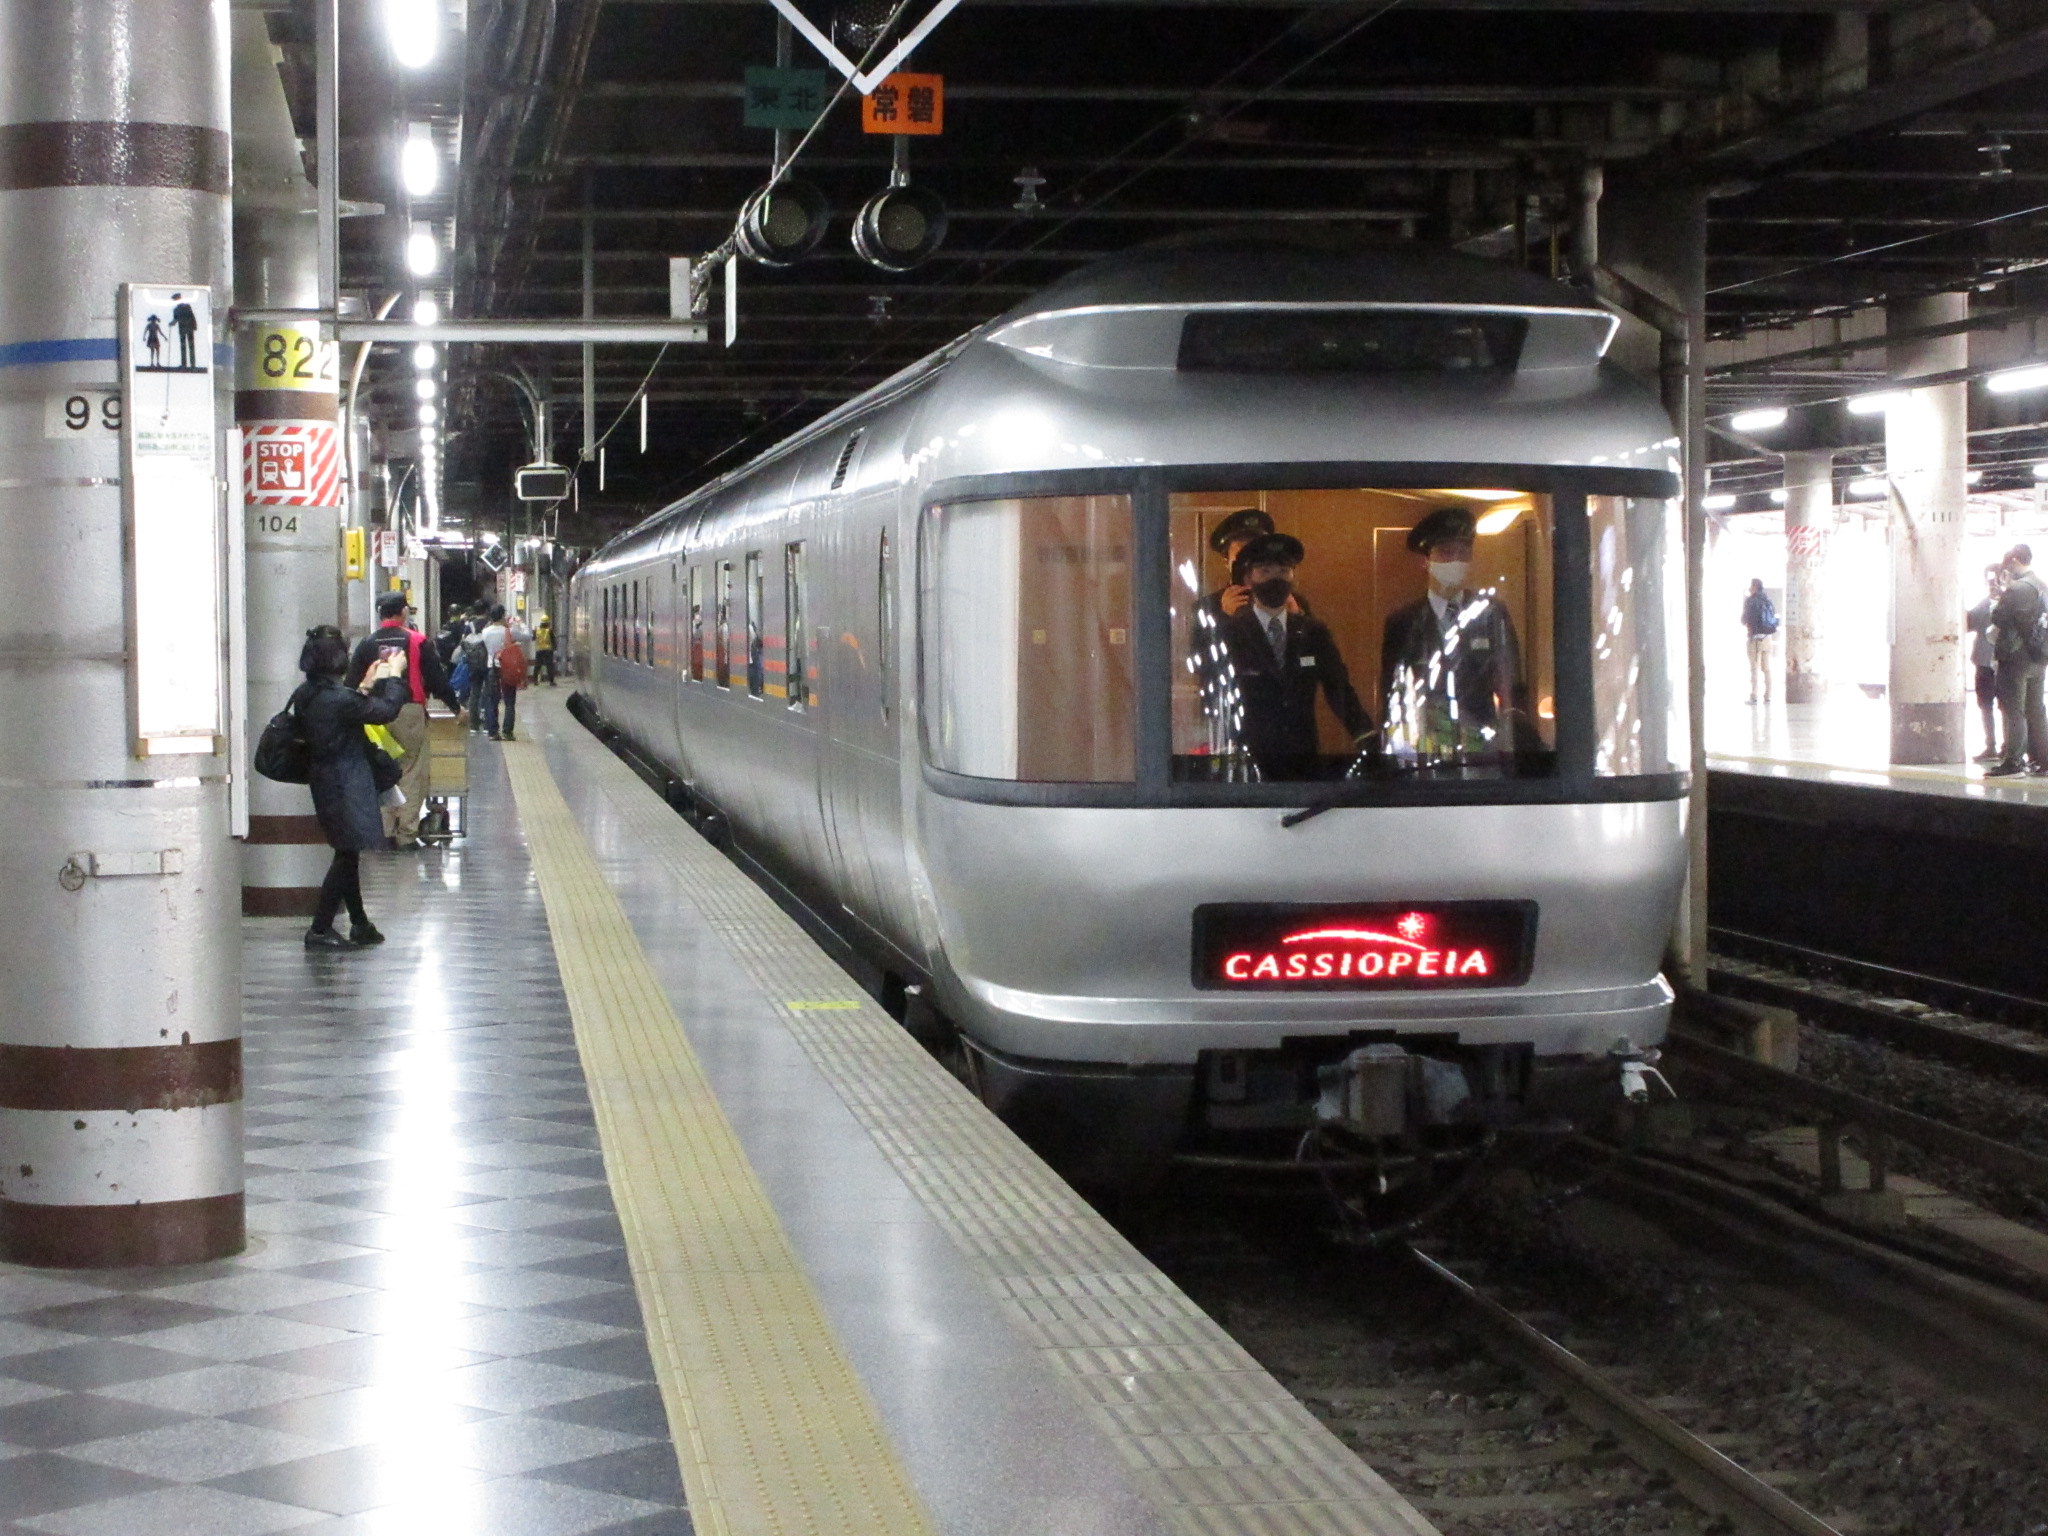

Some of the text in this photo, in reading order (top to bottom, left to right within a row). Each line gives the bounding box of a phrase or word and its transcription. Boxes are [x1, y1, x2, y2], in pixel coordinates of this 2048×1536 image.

[872, 85, 935, 123] 常磐
[263, 334, 332, 380] 822
[65, 396, 122, 430] 99
[260, 443, 303, 457] STOP
[258, 516, 297, 532] 104
[1226, 950, 1487, 978] CASSIOPEIA
